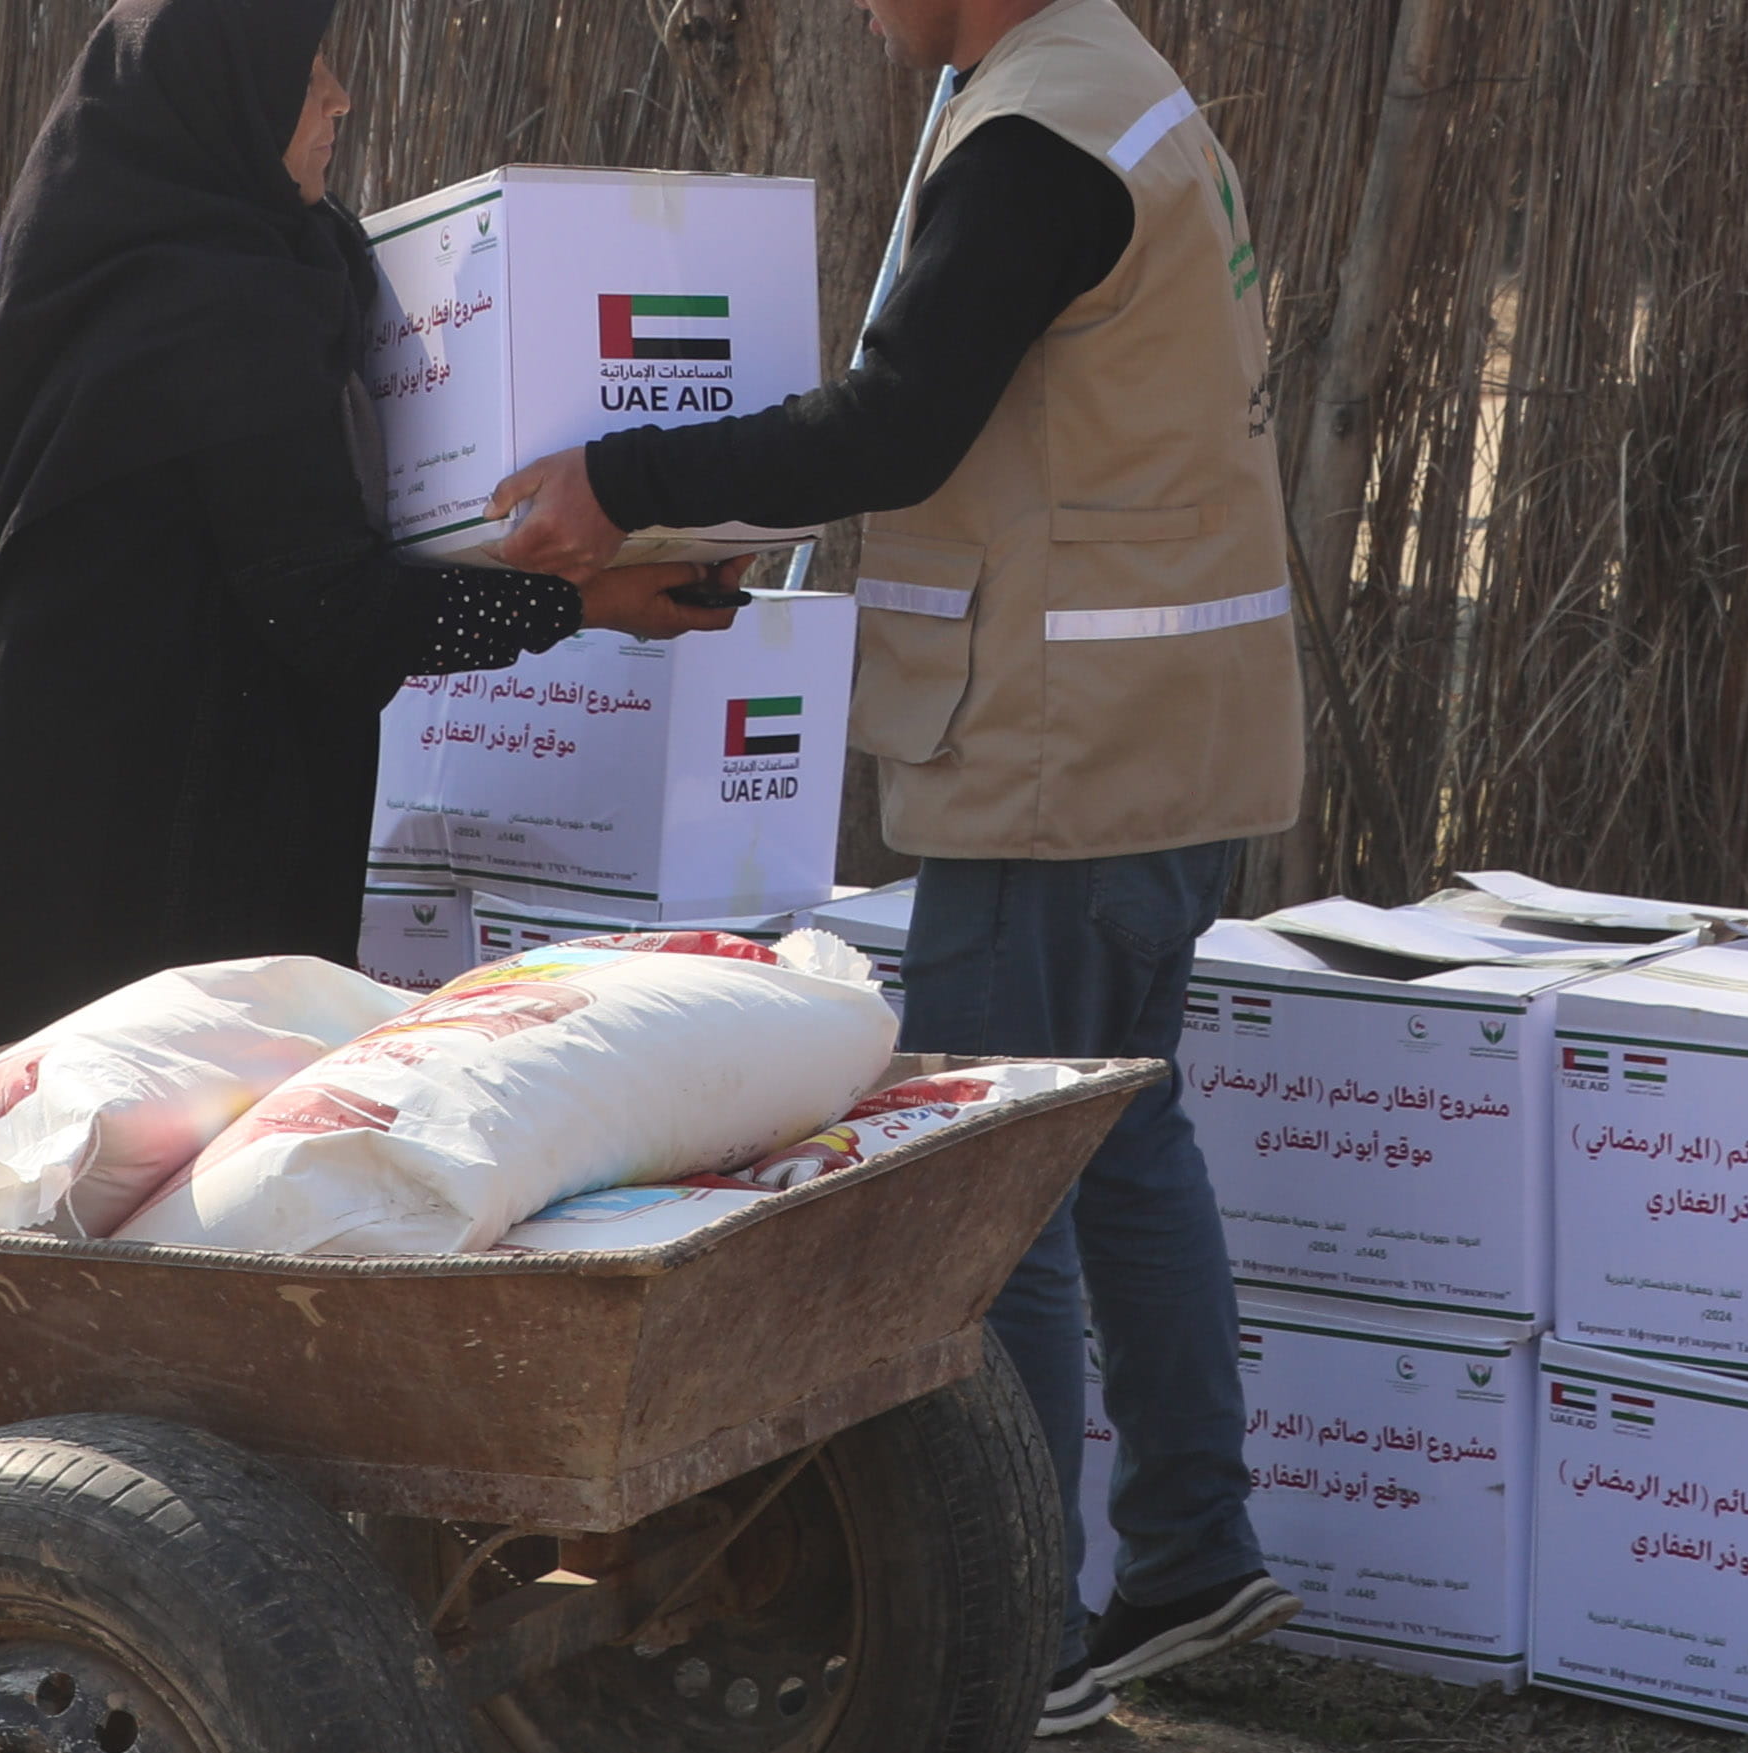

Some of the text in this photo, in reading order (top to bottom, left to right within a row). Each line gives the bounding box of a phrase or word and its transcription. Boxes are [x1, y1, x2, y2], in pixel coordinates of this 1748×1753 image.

[454, 290, 492, 328] مشروع
[425, 356, 450, 393] موقع
[601, 364, 732, 382] المساعدات الإماراتية
[601, 386, 733, 411] UAE AID
[491, 677, 535, 702] صائم
[538, 683, 583, 706] افطار
[587, 690, 651, 714] مشروع
[421, 722, 575, 758] موقع أبوذر الغفاري
[722, 777, 797, 802] UAE AID
[1201, 1066, 1277, 1097] الرمضاني
[1330, 1079, 1379, 1107] صائم
[1383, 1086, 1434, 1112] افطار
[1440, 1095, 1509, 1120] مشروع
[1256, 1127, 1432, 1168] موقع أبوذر الغفاري
[1586, 1127, 1671, 1160] الرمضاني
[1647, 1189, 1725, 1220] الغفاري
[1319, 1418, 1368, 1446] صائم
[1372, 1427, 1421, 1452] افطار
[1428, 1437, 1496, 1463] مشروع
[1320, 1472, 1420, 1509] موقع أبوذر
[1573, 1464, 1658, 1500] الرمضاني
[1632, 1533, 1711, 1562] الغفاري
